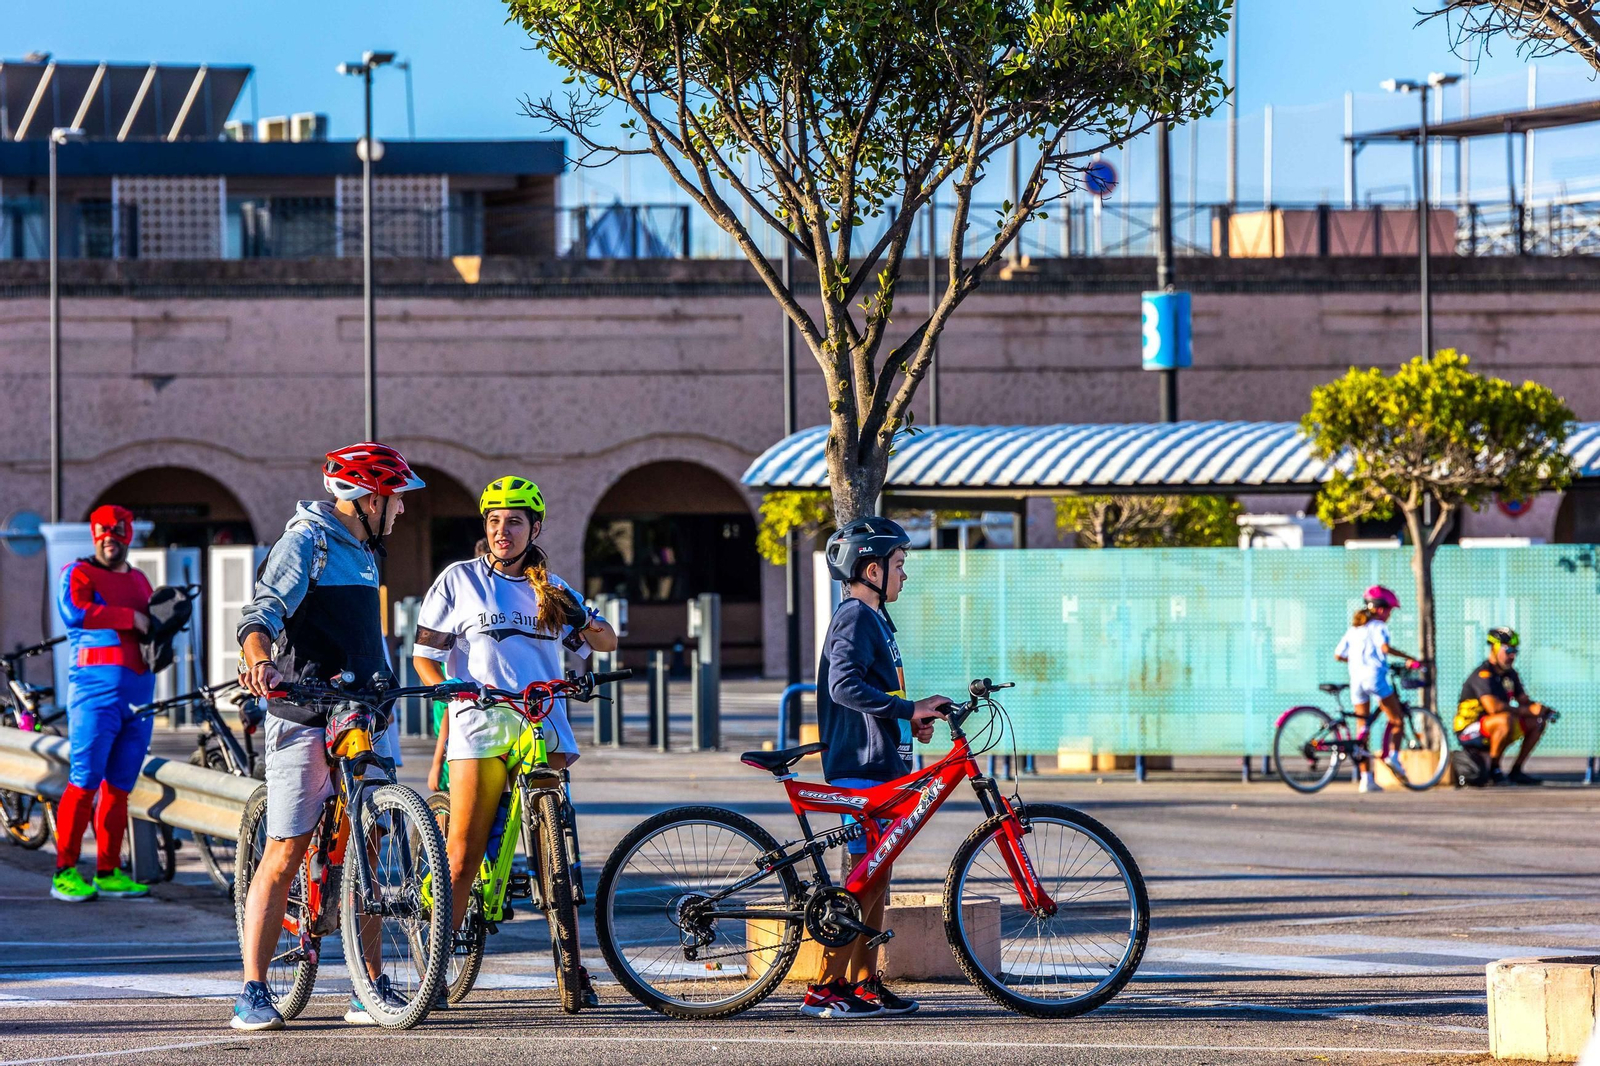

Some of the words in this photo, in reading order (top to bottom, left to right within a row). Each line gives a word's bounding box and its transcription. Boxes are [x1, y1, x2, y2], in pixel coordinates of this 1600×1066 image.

[858, 546, 873, 554] FILA
[478, 611, 506, 628] Los
[512, 611, 538, 630] Ang
